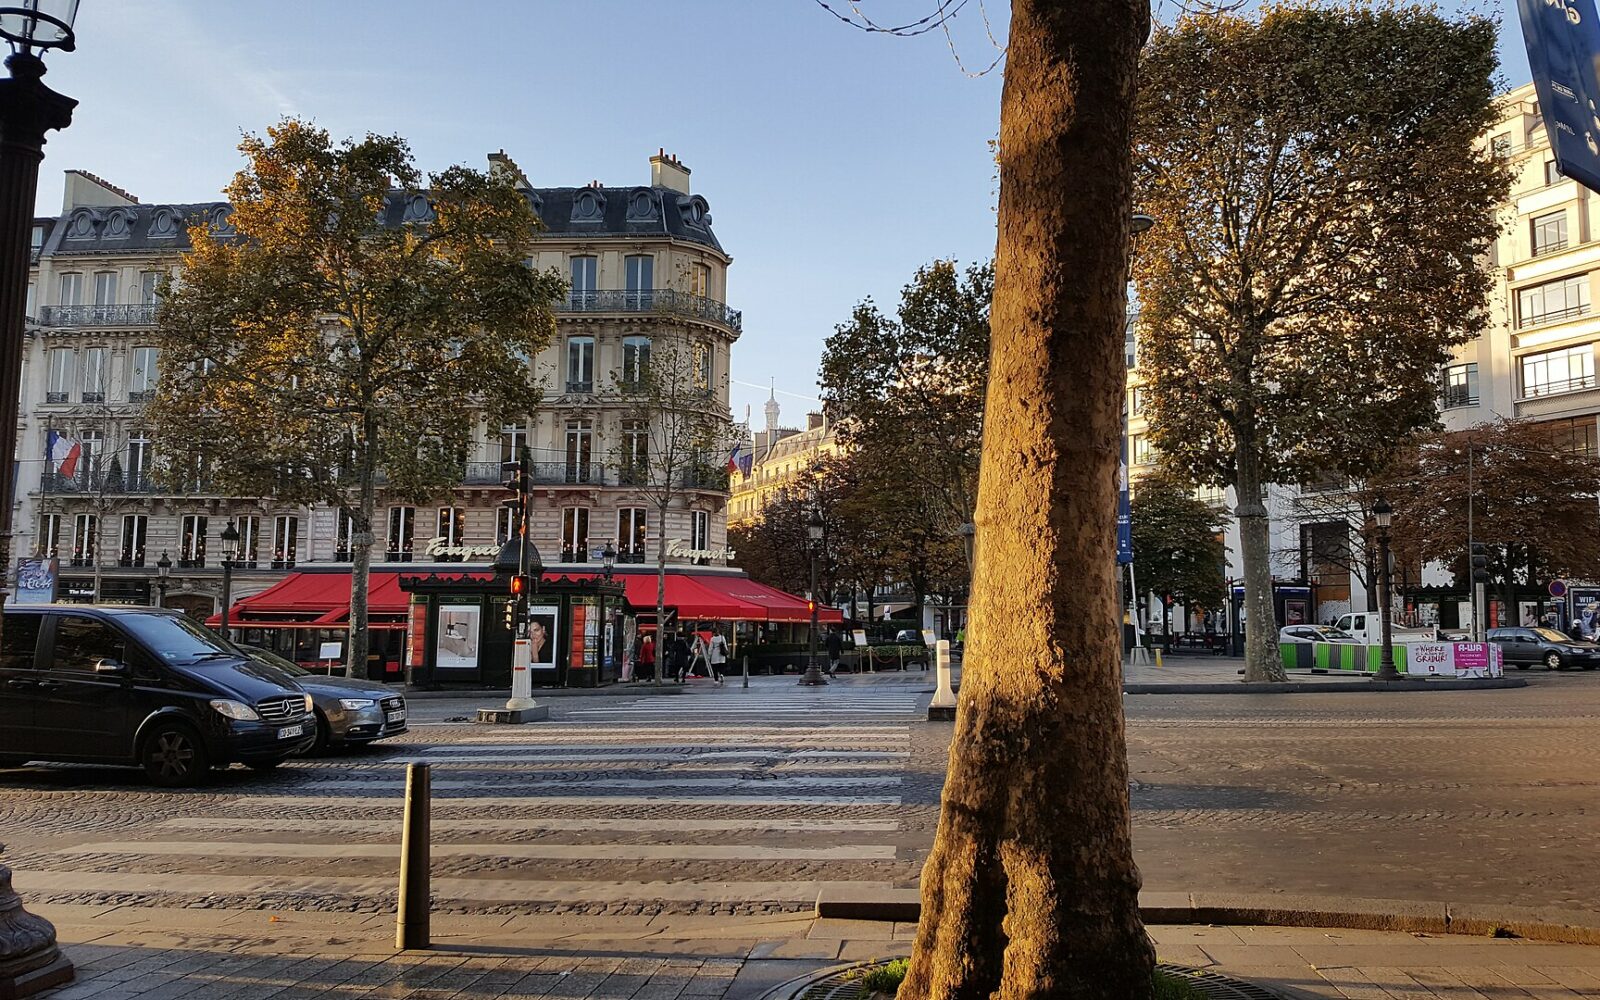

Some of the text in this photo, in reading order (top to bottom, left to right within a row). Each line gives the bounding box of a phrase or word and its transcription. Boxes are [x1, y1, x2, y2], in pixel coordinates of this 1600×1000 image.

[426, 537, 503, 561] Fouque
[666, 538, 736, 564] Fouquet's
[1458, 644, 1483, 652] A-WA
